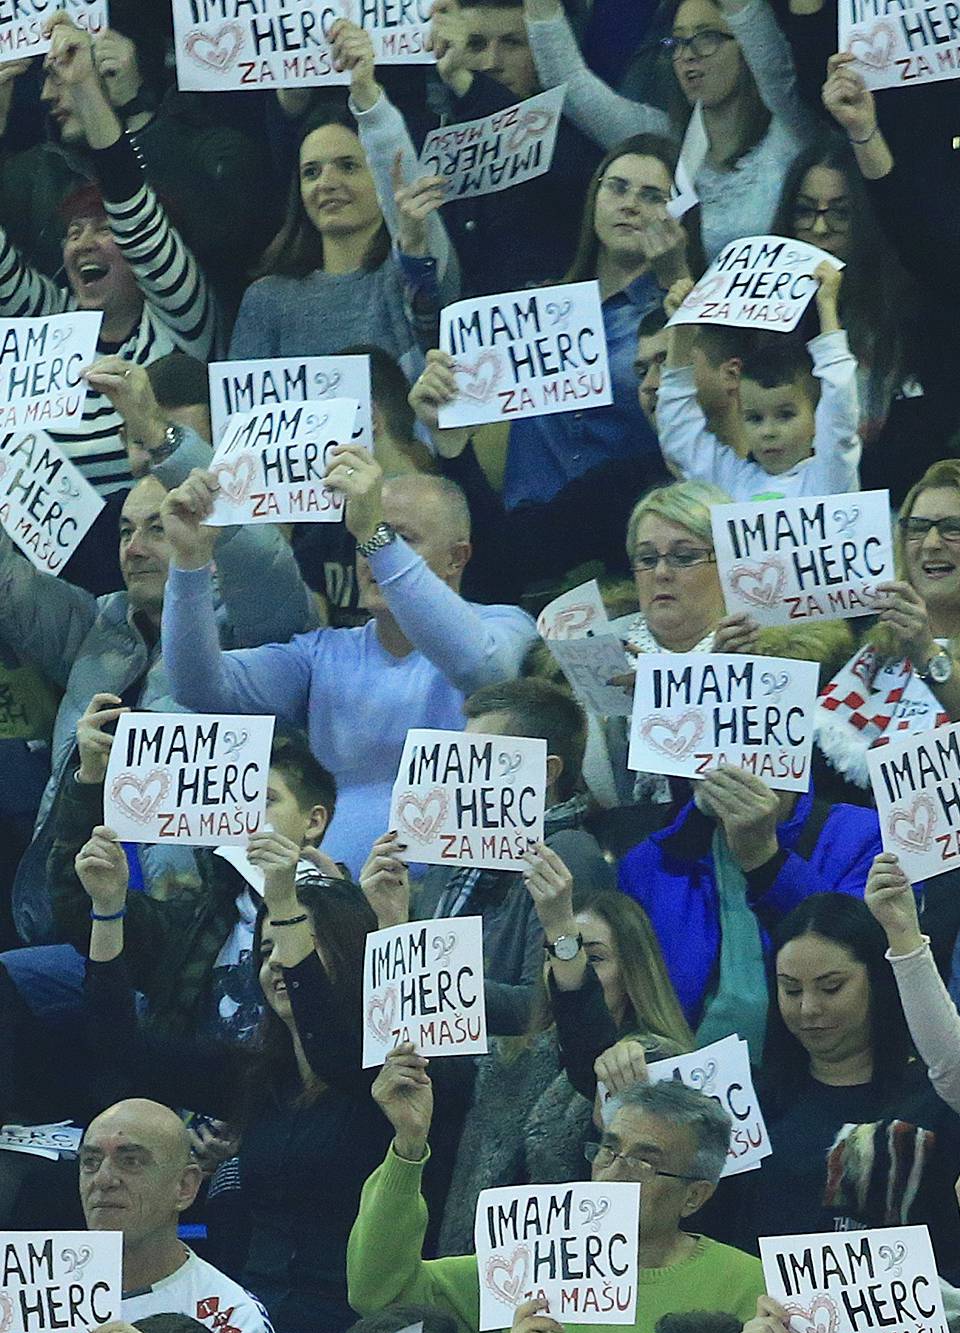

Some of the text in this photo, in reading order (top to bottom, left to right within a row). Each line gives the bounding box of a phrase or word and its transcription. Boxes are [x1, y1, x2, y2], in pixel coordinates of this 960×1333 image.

[251, 8, 341, 54] HERC
[239, 61, 275, 84] ZA
[895, 58, 928, 80] ZA
[485, 110, 518, 134] ZA
[424, 135, 505, 175] HERC
[725, 272, 817, 302] HERC
[449, 296, 541, 355] IMAM
[698, 302, 730, 321] ZA
[8, 353, 83, 401] HERC
[507, 328, 599, 384] HERC
[222, 364, 307, 415] IMAM
[499, 371, 606, 414] ZA MAŠU
[228, 405, 302, 453] IMAM
[262, 442, 335, 486] HERC
[6, 470, 77, 548] HERC
[250, 492, 281, 517] ZA
[727, 503, 825, 560] IMAM
[793, 537, 885, 591] HERC
[784, 597, 824, 619] ZA
[652, 662, 753, 709] IMAM
[126, 722, 218, 767] IMAM
[713, 706, 805, 747] HERC
[408, 741, 493, 785] IMAM
[176, 764, 261, 808] HERC
[157, 809, 262, 837] ZA MAŠU
[455, 787, 538, 830] HERC
[440, 834, 473, 859] ZA
[370, 927, 427, 989] IMAM
[399, 966, 477, 1021] HERC
[418, 1014, 482, 1049] MAŠU
[486, 1190, 573, 1248] IMAM
[532, 1232, 629, 1283] HERC
[776, 1238, 875, 1296] IMAM
[19, 1281, 112, 1331] HERC
[560, 1281, 632, 1314] MAŠU
[841, 1276, 936, 1331] HERC
